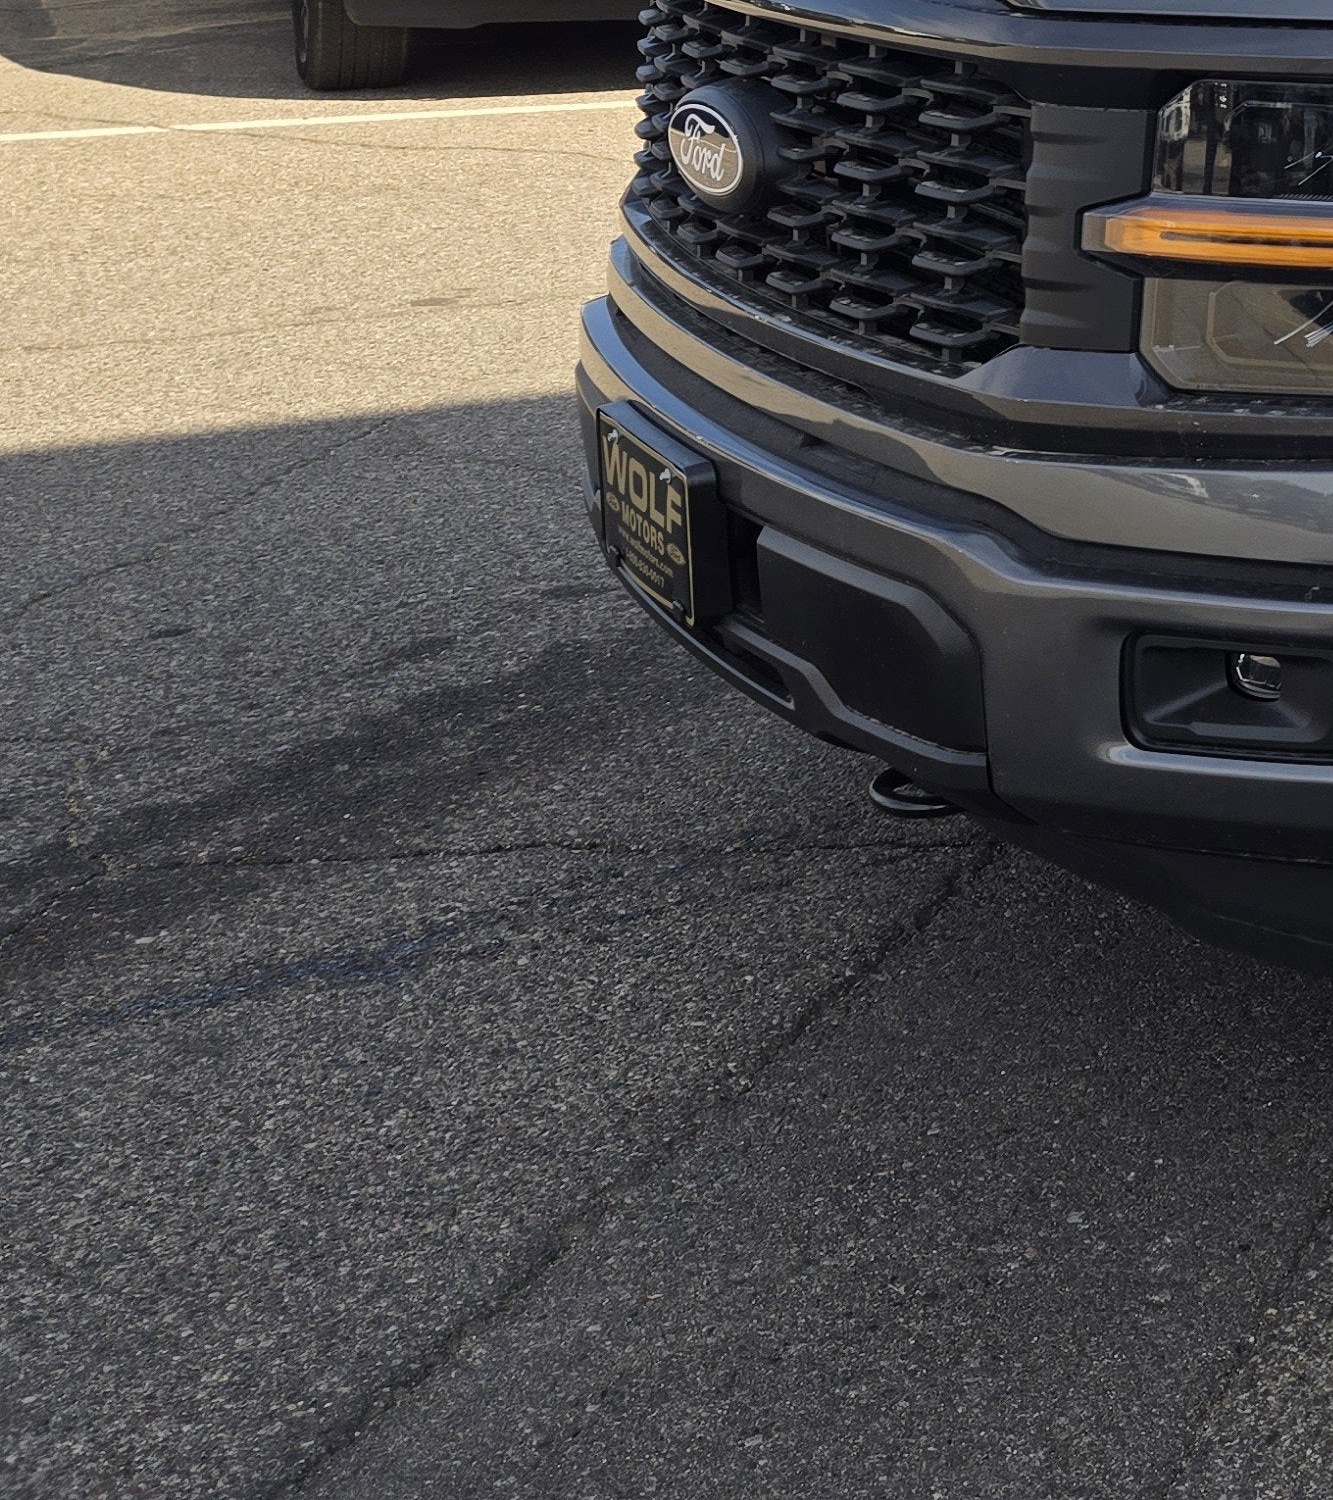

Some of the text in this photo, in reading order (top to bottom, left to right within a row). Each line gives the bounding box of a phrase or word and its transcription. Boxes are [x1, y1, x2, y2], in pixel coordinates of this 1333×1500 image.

[681, 113, 726, 182] Ford
[602, 435, 682, 534] WOLF
[621, 500, 665, 556] MOTORS
